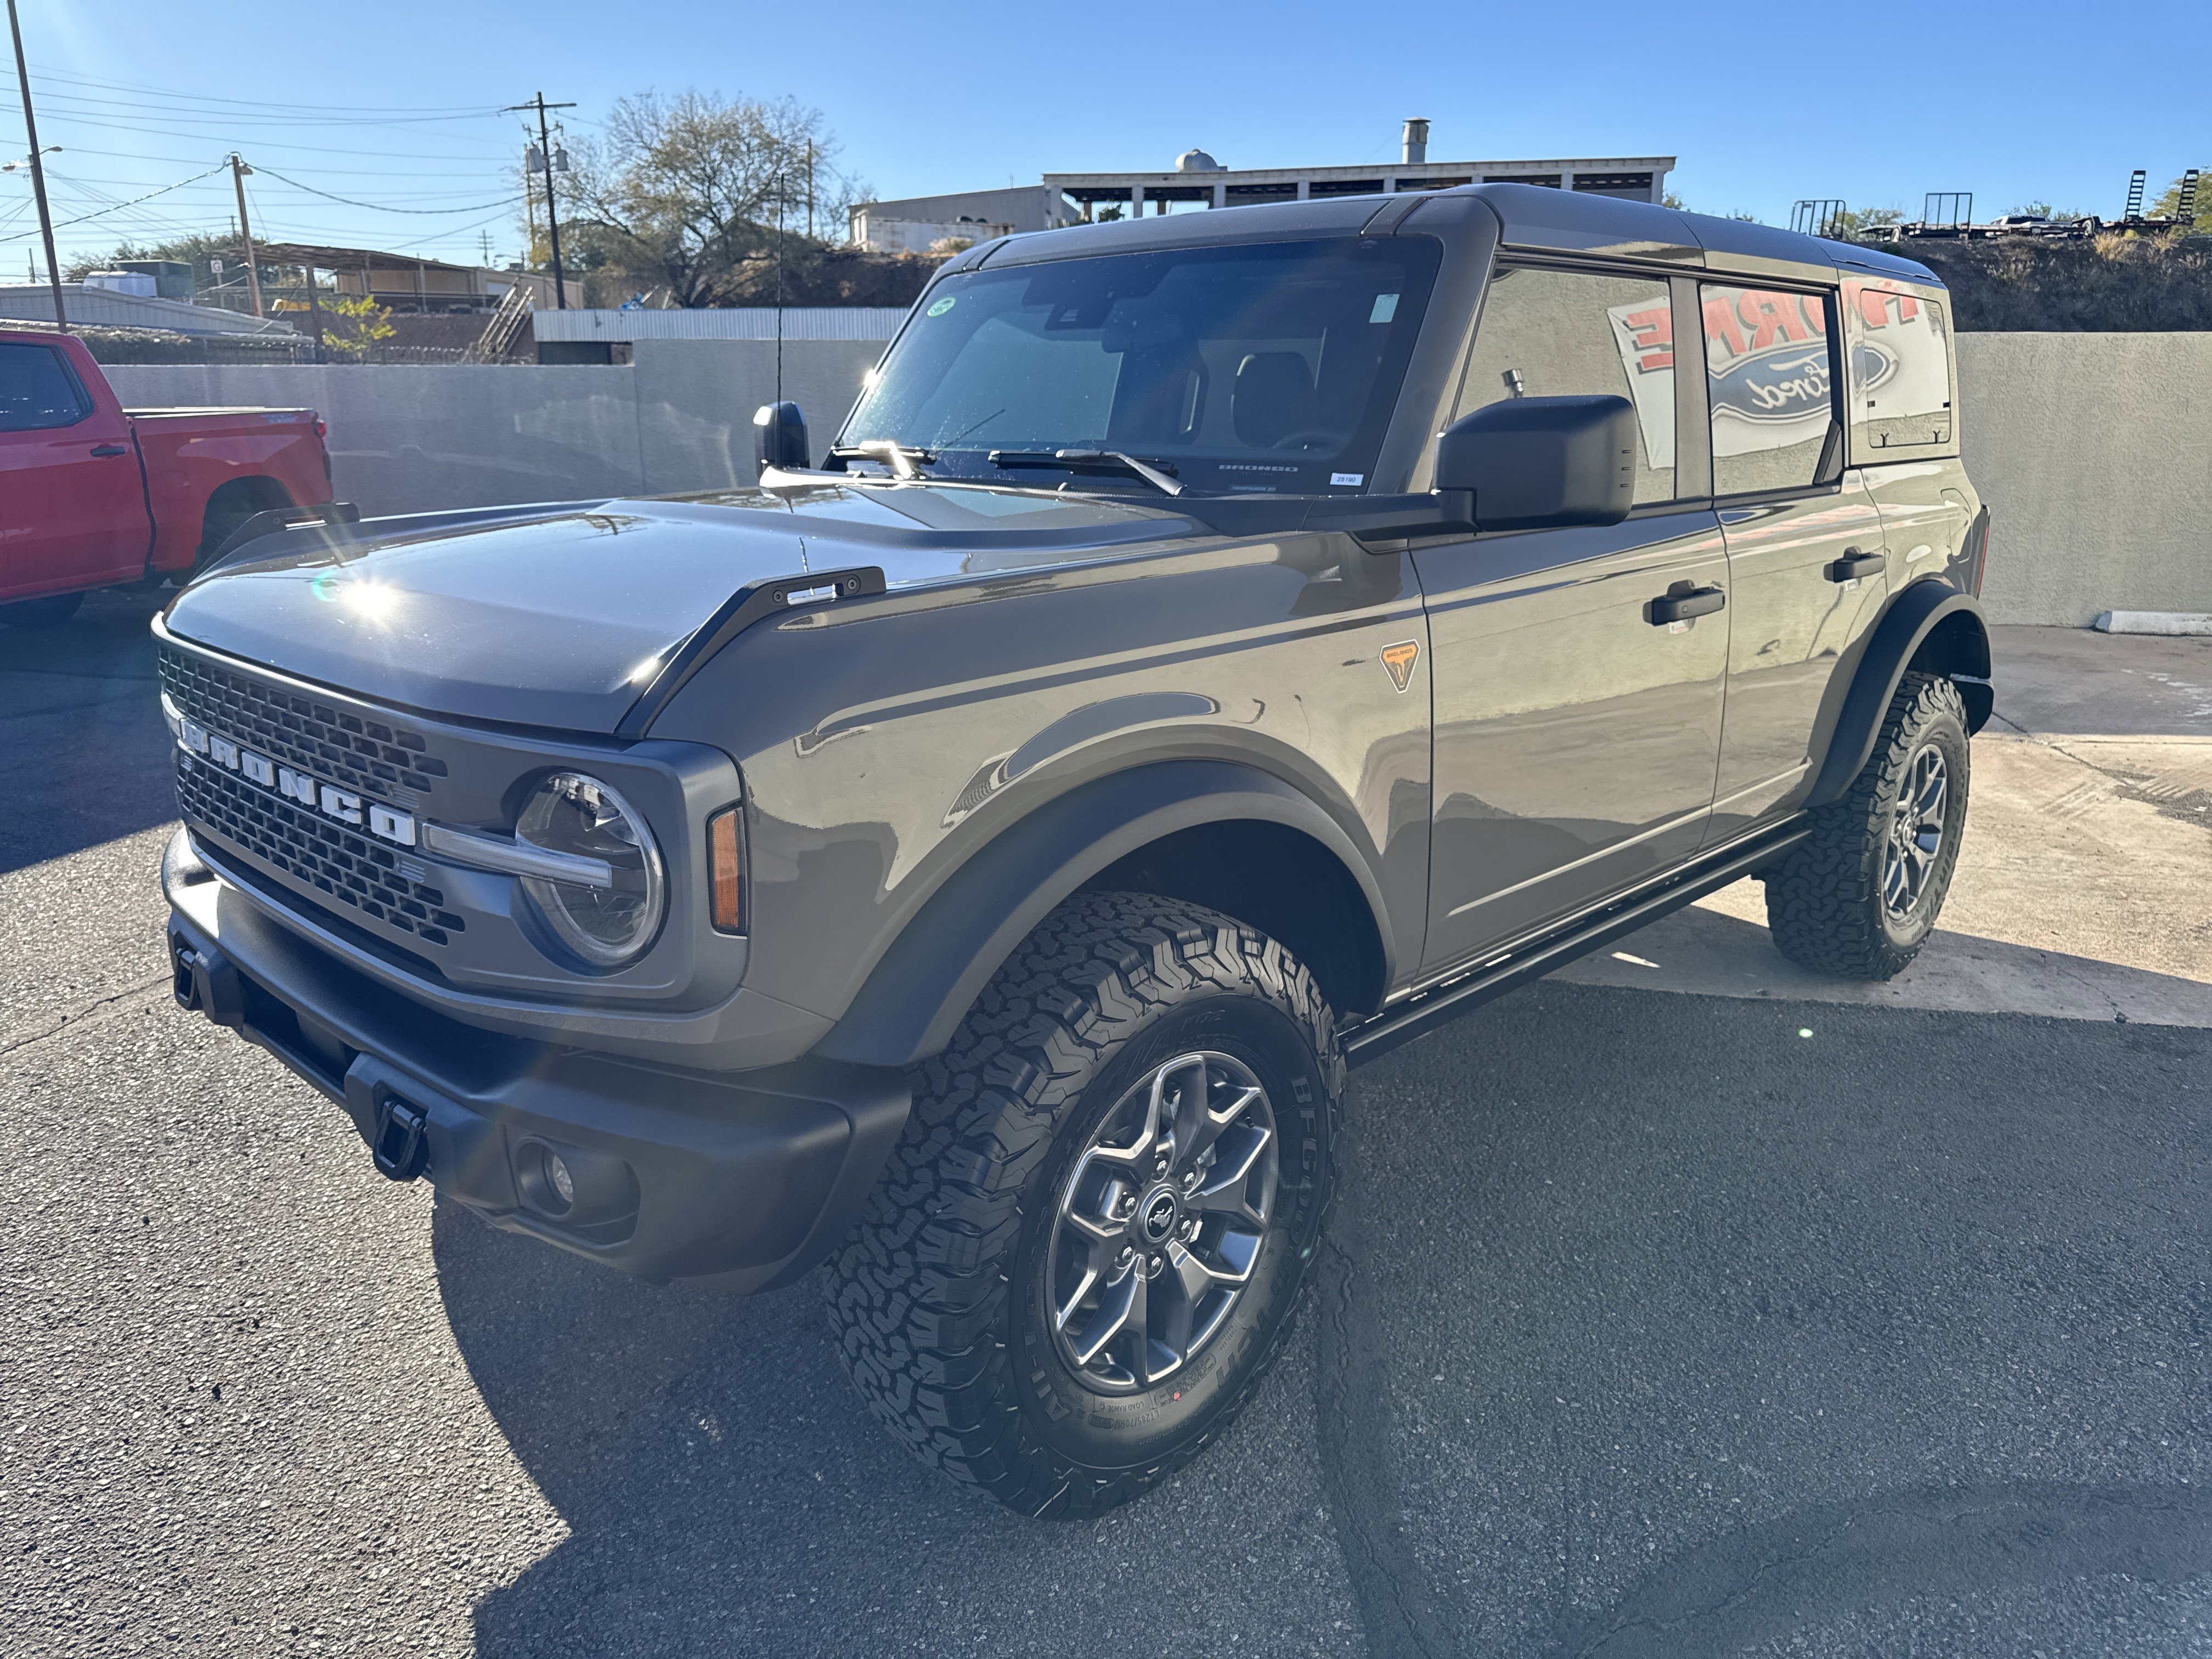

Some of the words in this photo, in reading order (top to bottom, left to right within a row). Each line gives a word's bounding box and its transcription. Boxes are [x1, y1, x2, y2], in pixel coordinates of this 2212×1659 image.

[1387, 648, 1413, 658] BADLANDS
[183, 718, 416, 847] BRONCO
[1215, 1074, 1317, 1388] BFGoodrich
[1108, 1404, 1127, 1413] RANGE
[1128, 1401, 1144, 1410] LOAD
